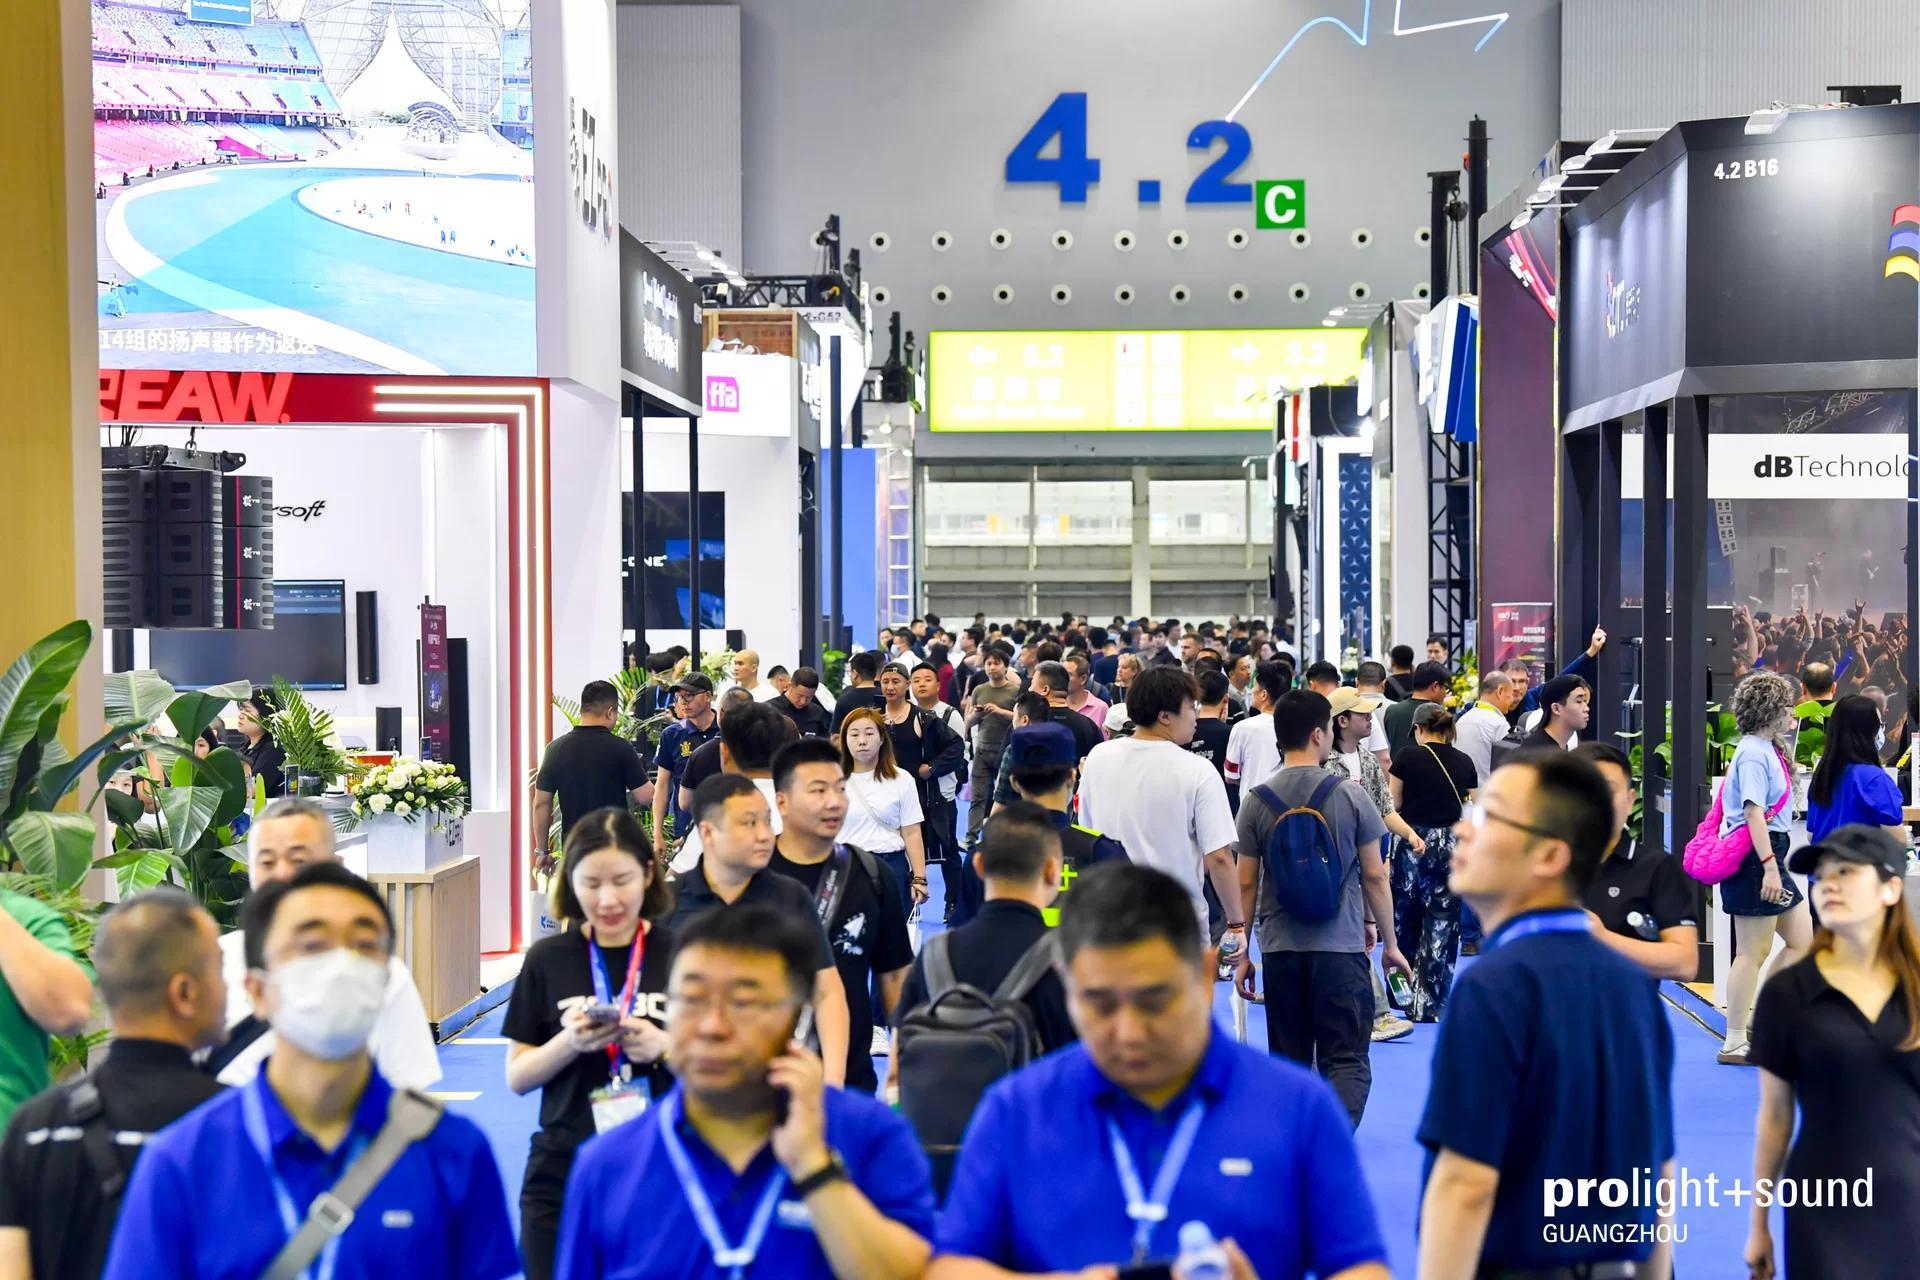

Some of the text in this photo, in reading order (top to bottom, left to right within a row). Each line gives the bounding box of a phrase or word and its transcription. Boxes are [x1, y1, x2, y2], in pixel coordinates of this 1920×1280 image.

[1005, 92, 1253, 203] 4.2
[1713, 158, 1779, 180] 4.2 B16
[1264, 185, 1297, 223] C
